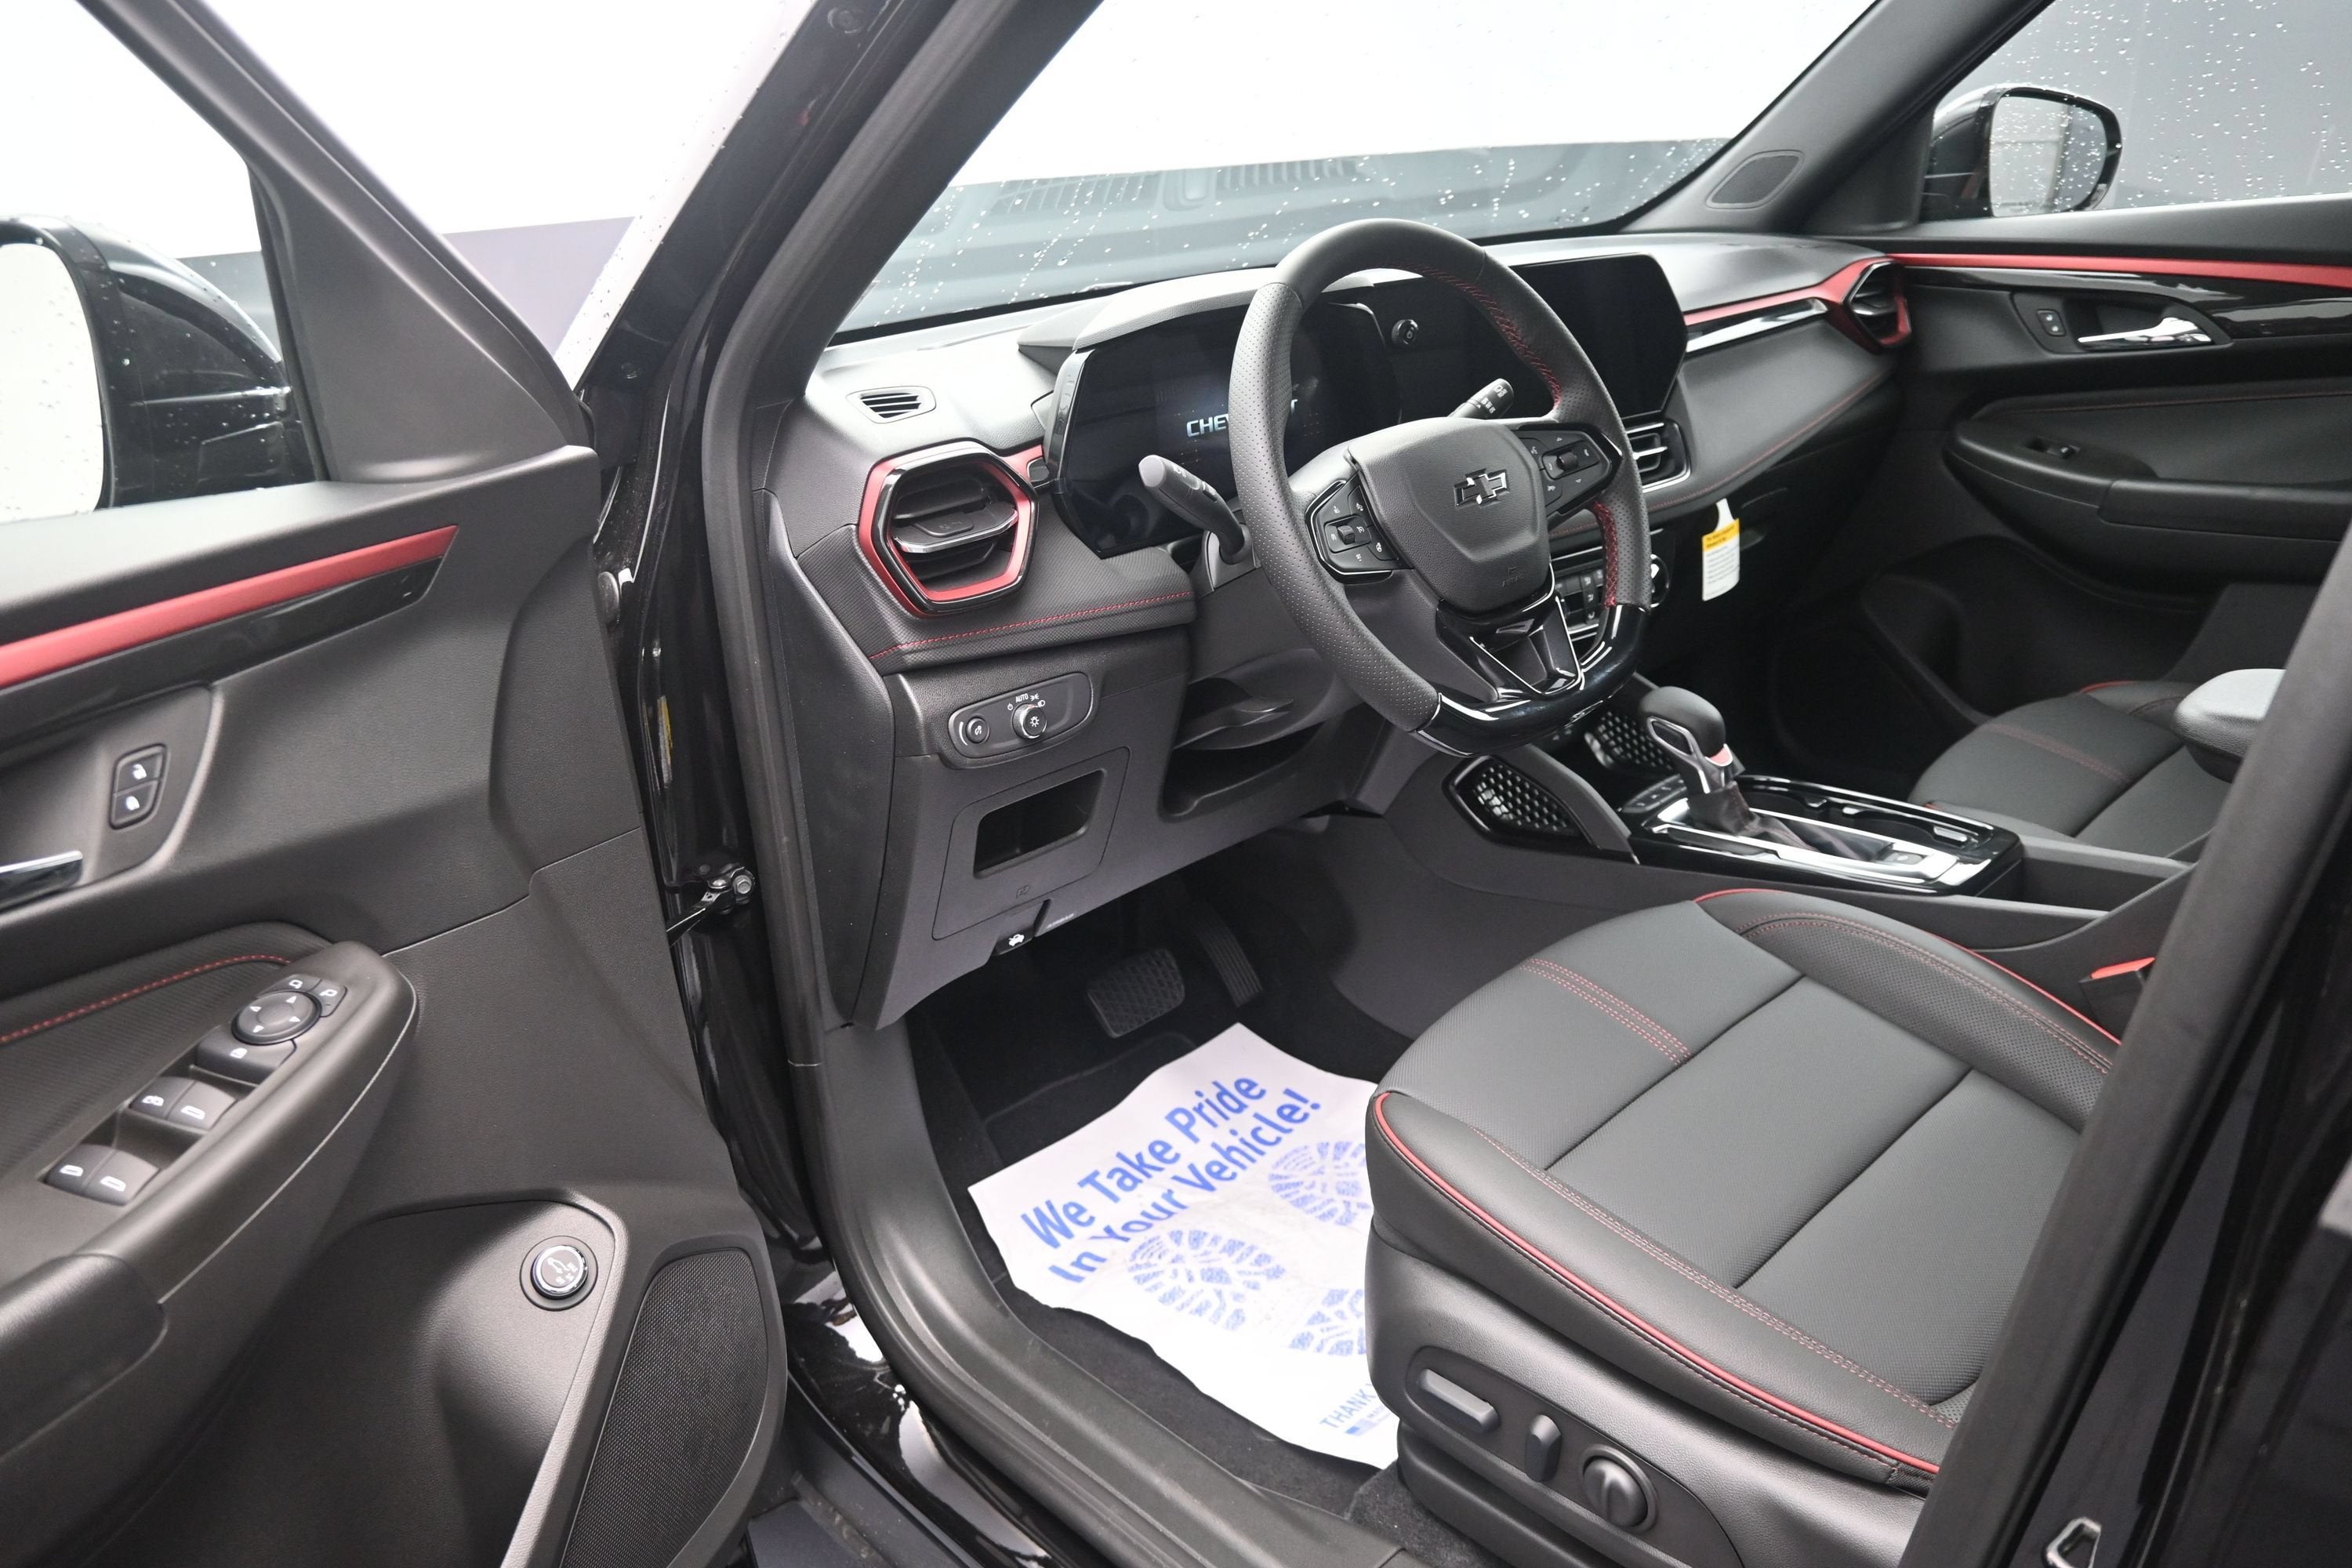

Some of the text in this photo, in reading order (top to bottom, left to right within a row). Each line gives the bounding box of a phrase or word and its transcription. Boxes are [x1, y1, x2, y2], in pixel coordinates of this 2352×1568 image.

[1015, 693, 1029, 703] AUTO
[1020, 1077, 1267, 1249] We Take Pride
[1047, 1087, 1321, 1283] In Your Vehicle!
[1319, 1388, 1377, 1428] THANK
